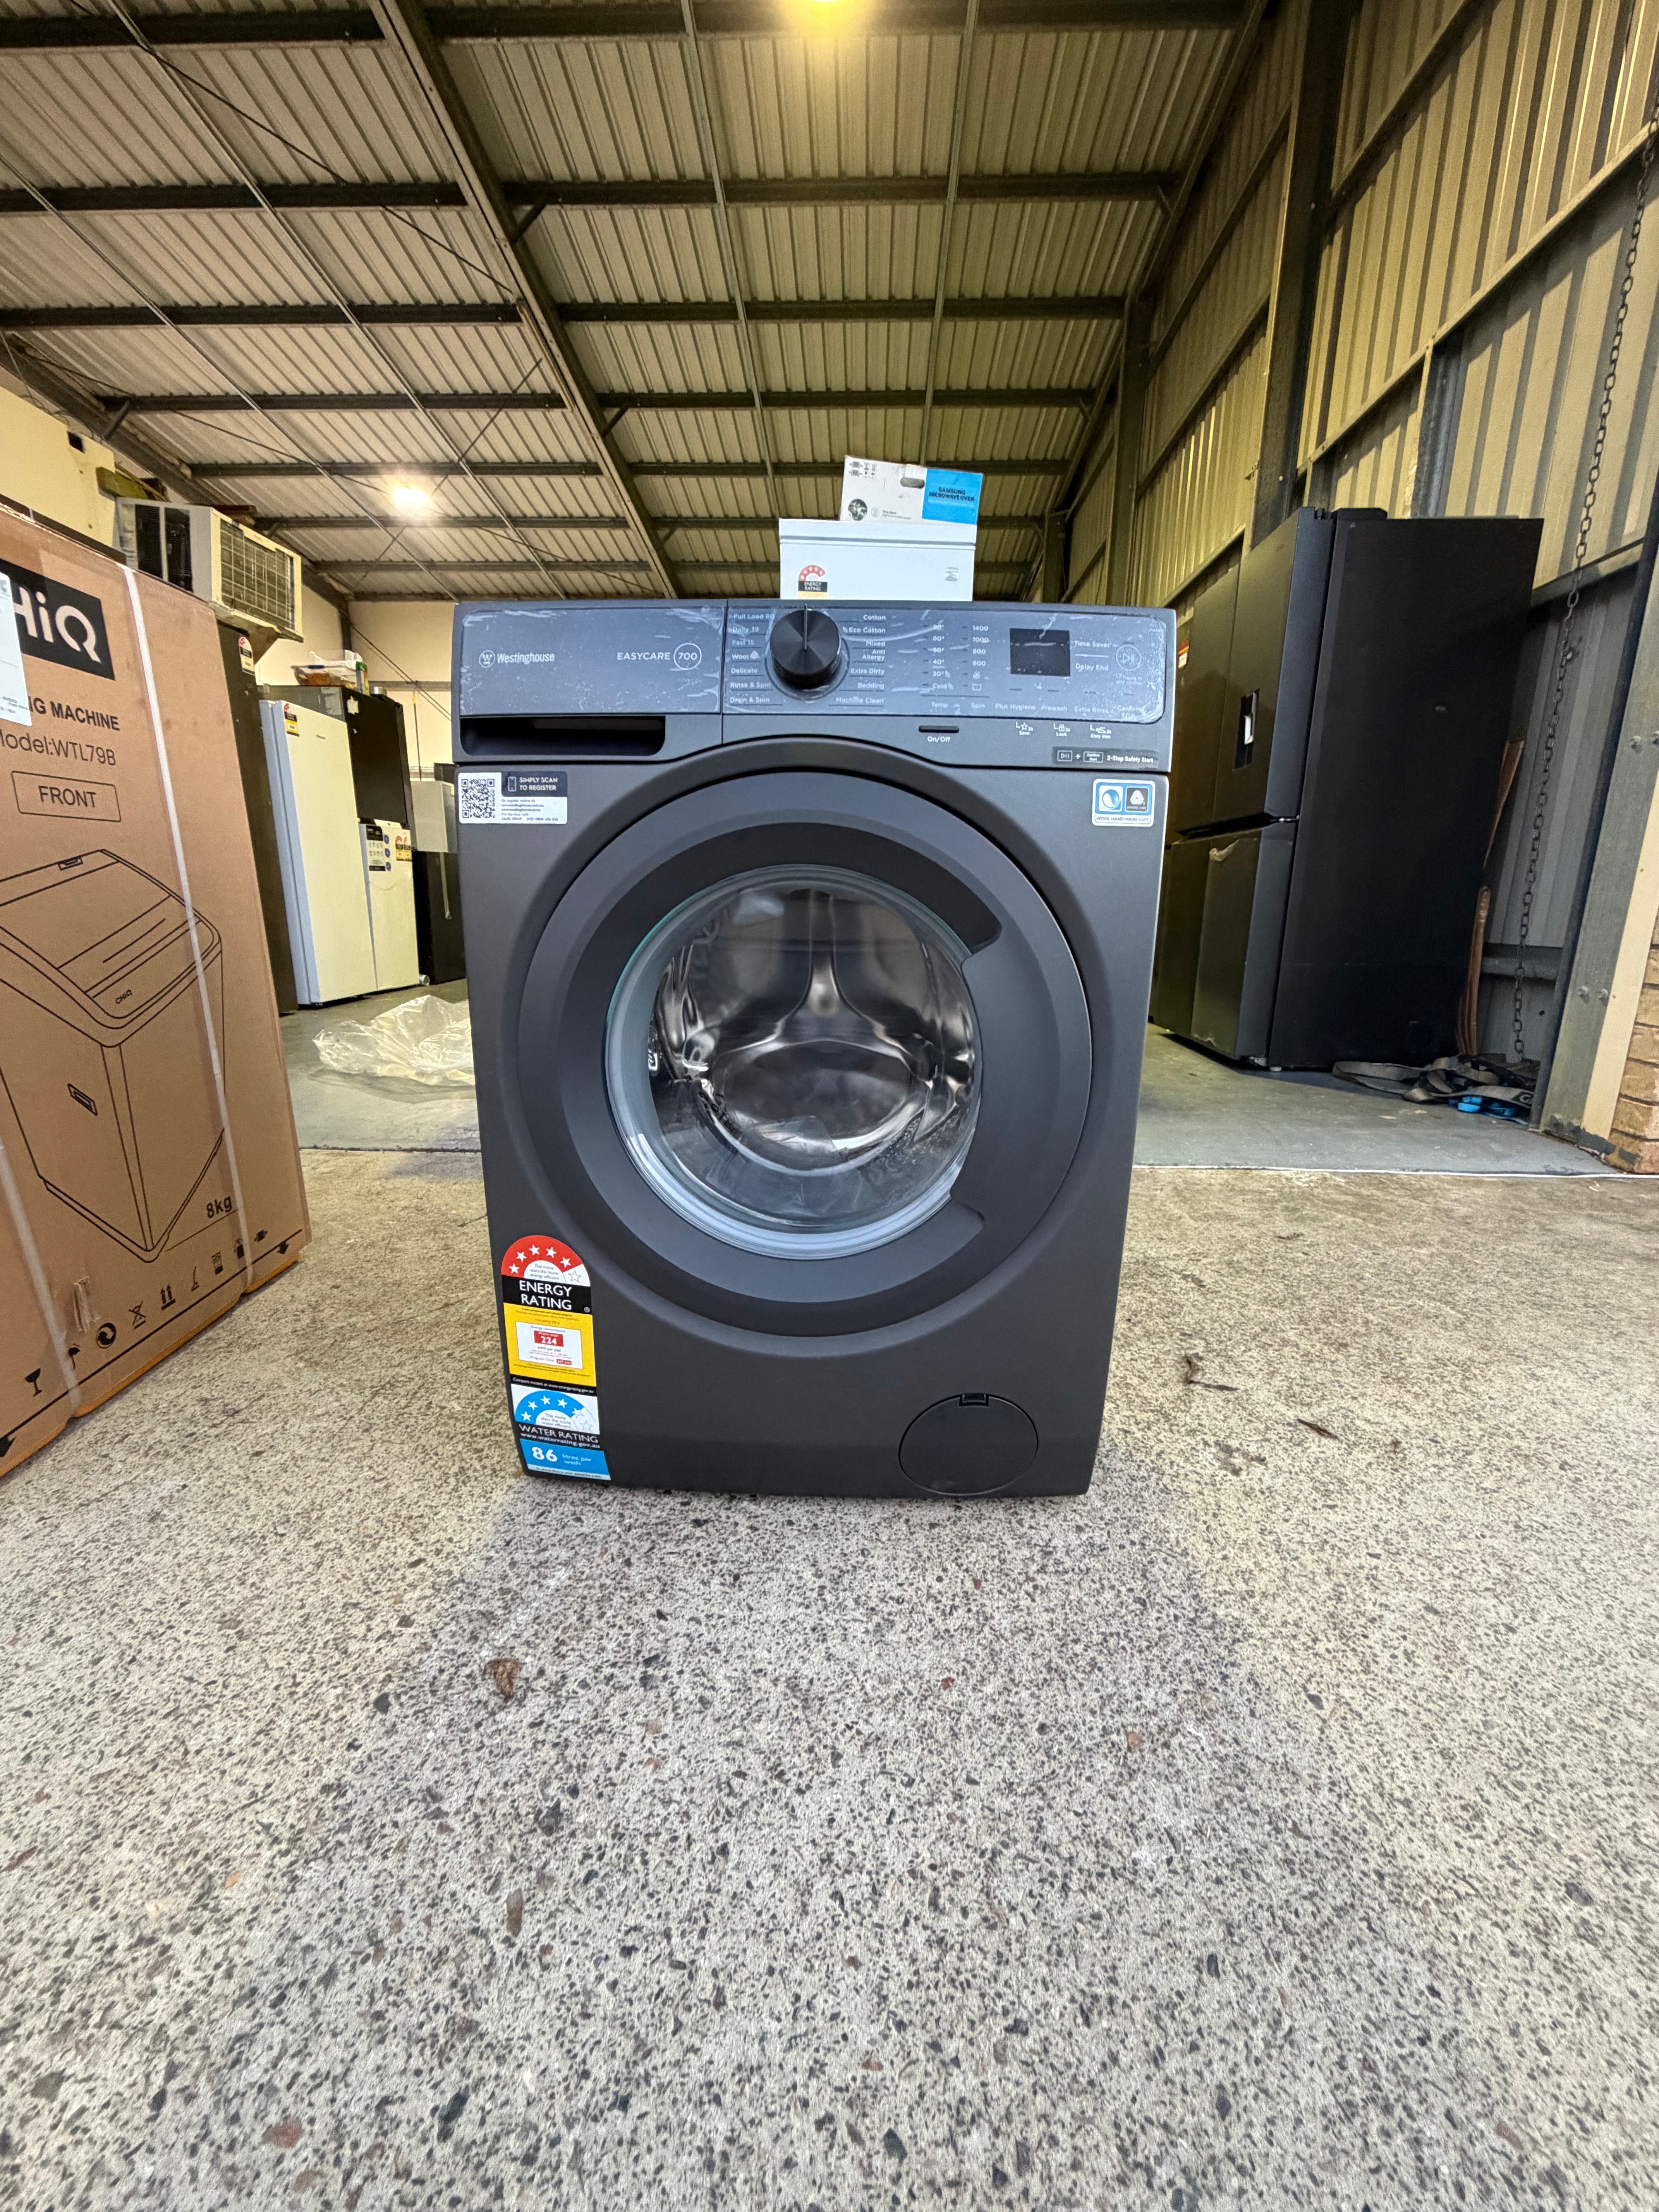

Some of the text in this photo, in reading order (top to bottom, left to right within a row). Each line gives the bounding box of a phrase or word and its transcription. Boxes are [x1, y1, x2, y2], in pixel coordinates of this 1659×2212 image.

[929, 491, 960, 500] MICROWAVE
[497, 652, 555, 665] Westinghouse
[617, 652, 697, 660] EASYCARE 700
[50, 701, 120, 731] MACHINE
[927, 735, 950, 743] On/Off
[38, 785, 96, 808] FRONT
[206, 1196, 232, 1218] 8kg
[519, 1280, 572, 1297] ENERGY
[521, 1293, 572, 1310] RATING
[541, 1336, 557, 1345] 224
[519, 1424, 598, 1443] WATER RATING
[520, 1433, 600, 1449] www.waterrating.gov.au
[532, 1447, 558, 1462] 86
